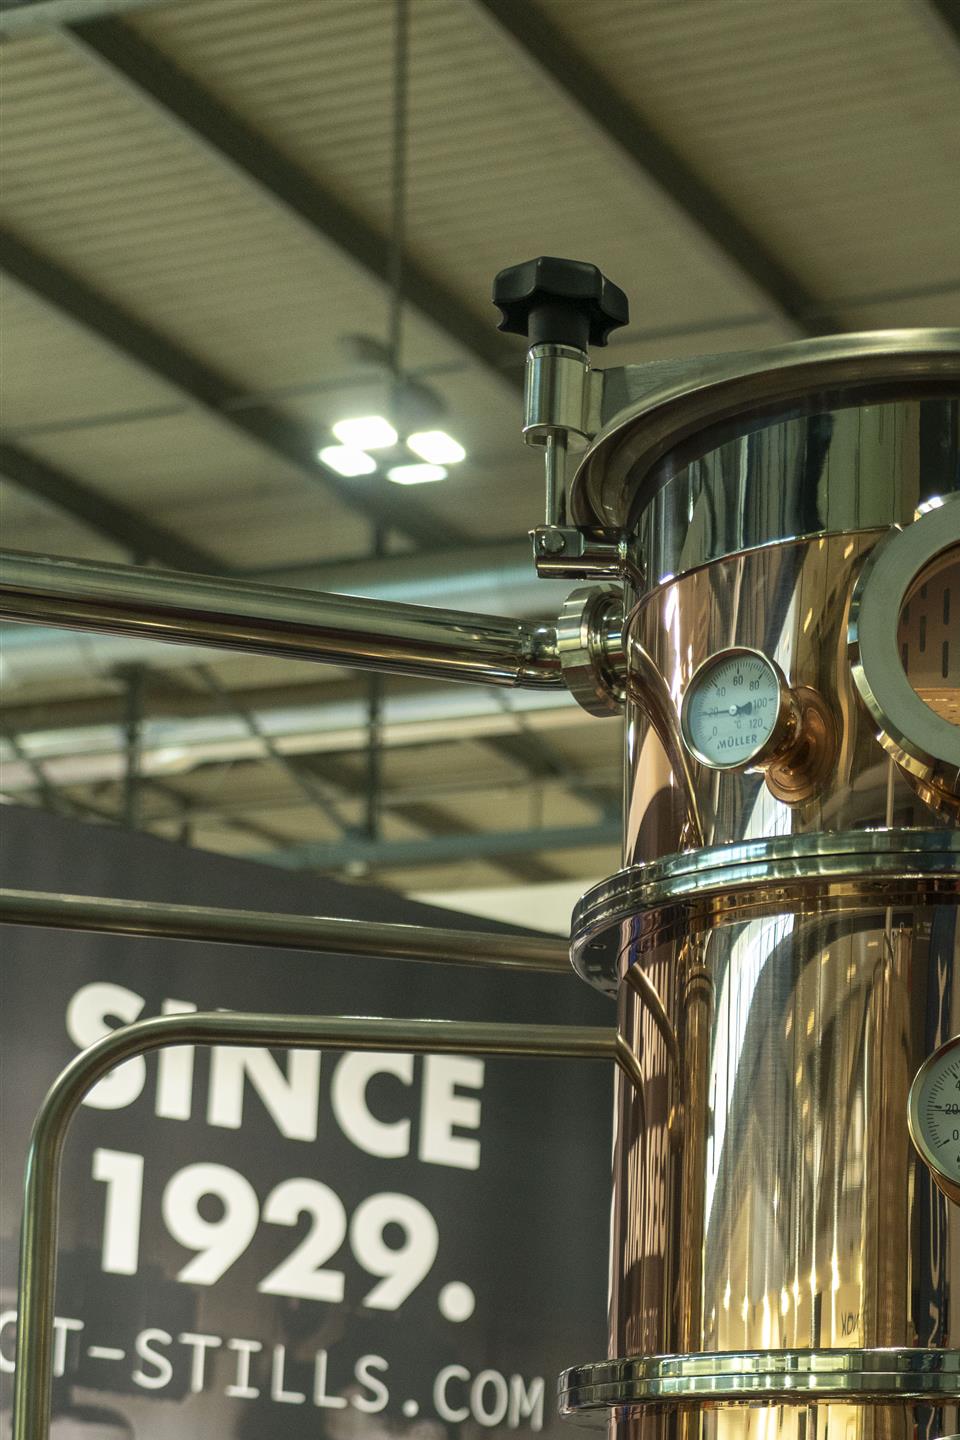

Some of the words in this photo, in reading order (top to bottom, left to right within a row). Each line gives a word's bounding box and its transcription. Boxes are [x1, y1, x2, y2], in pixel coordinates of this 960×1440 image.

[733, 675, 744, 686] 60
[749, 680, 760, 692] 80
[749, 718, 763, 729] 120
[717, 734, 758, 750] MÜLLER
[66, 981, 485, 1170] SINCE
[945, 1103, 959, 1115] 20
[952, 1129, 959, 1141] 0
[92, 1148, 476, 1323] 1929.
